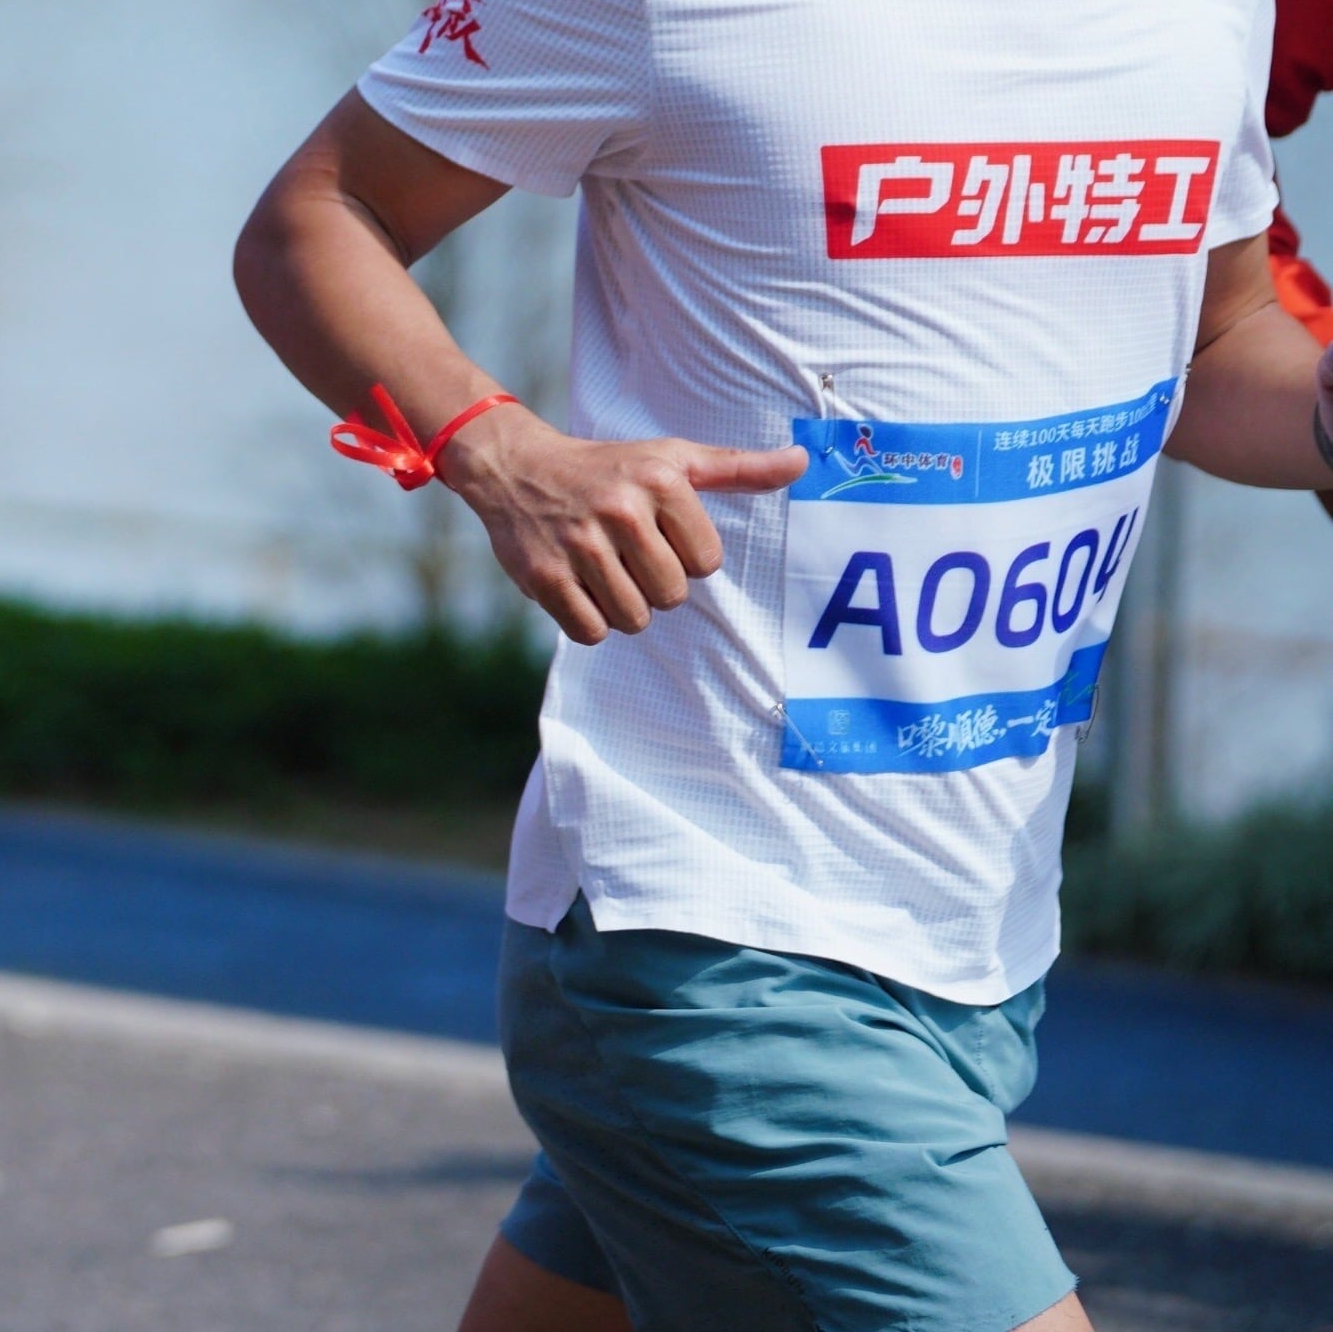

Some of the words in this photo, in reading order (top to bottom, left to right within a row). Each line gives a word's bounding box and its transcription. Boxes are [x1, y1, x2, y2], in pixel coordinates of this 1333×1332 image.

[849, 154, 1212, 246] 户外特工
[1026, 433, 1140, 489] 极限挑战
[807, 507, 1139, 656] A0604
